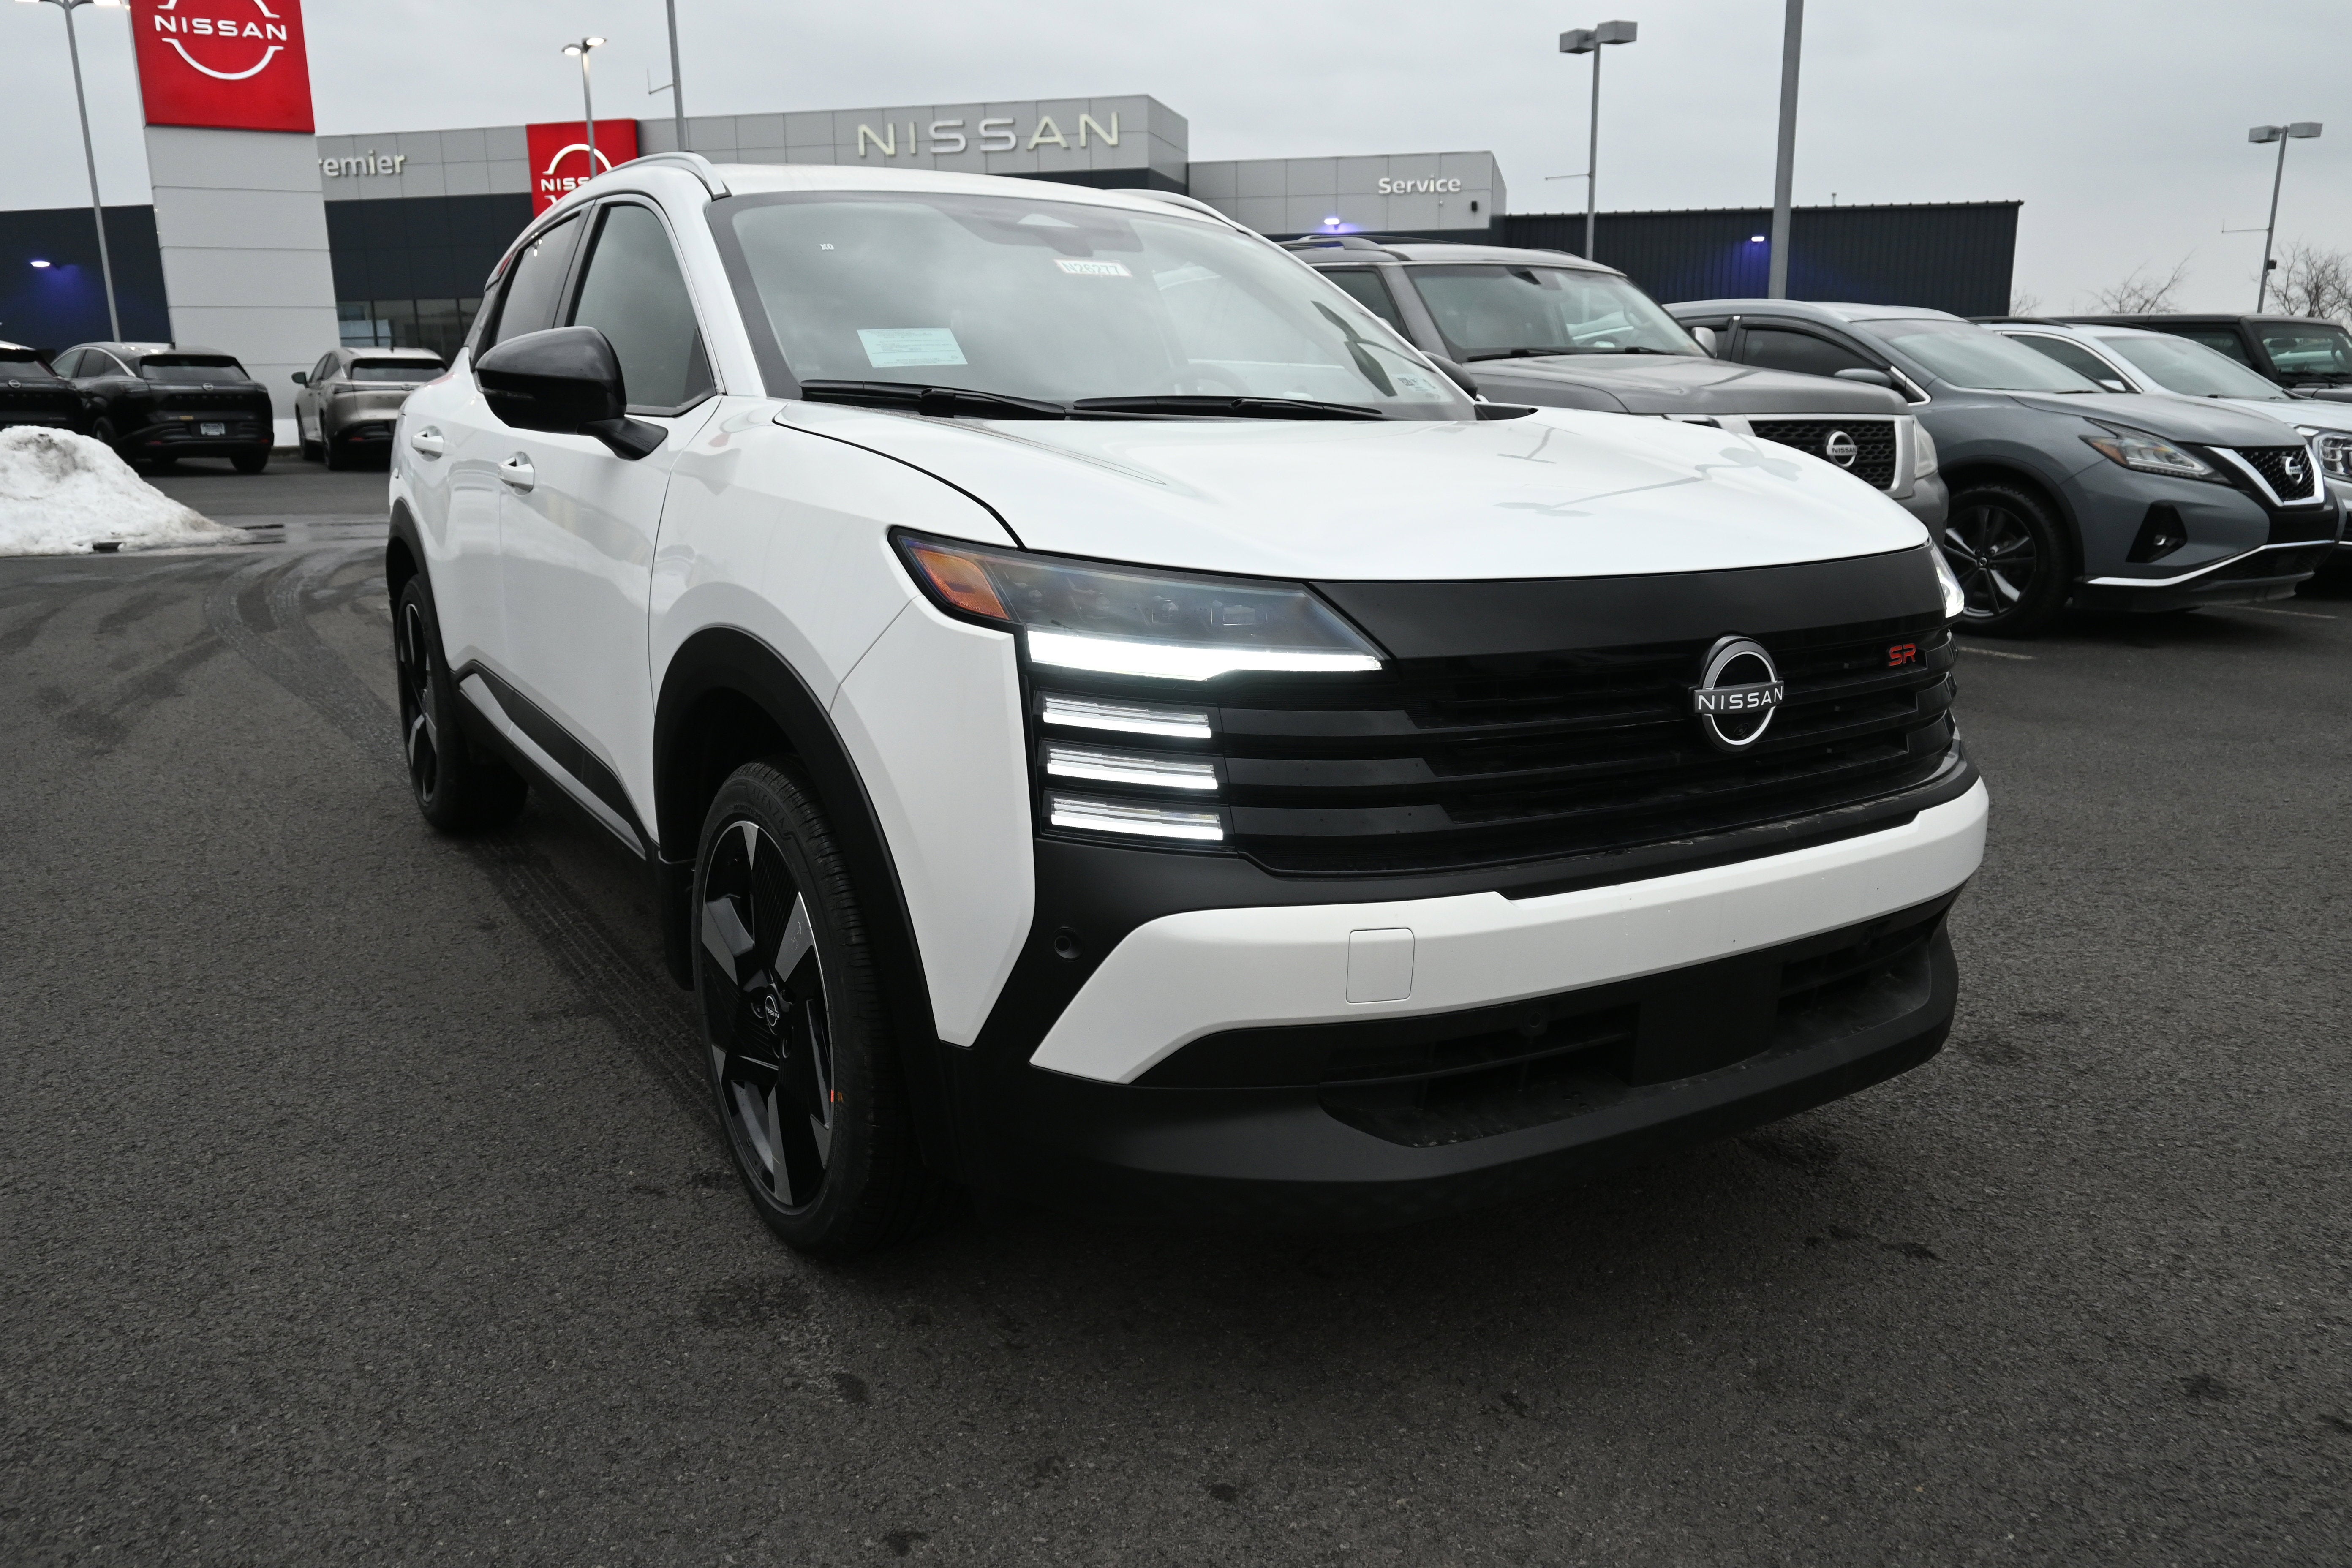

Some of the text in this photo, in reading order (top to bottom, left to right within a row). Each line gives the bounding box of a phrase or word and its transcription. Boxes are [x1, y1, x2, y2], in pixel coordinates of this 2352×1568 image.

[155, 15, 287, 41] NISSAN
[858, 112, 1120, 157] NISSAN
[318, 149, 406, 177] emier
[1378, 174, 1462, 195] Service
[1889, 643, 1916, 667] SR
[1698, 685, 1784, 710] NISSAN
